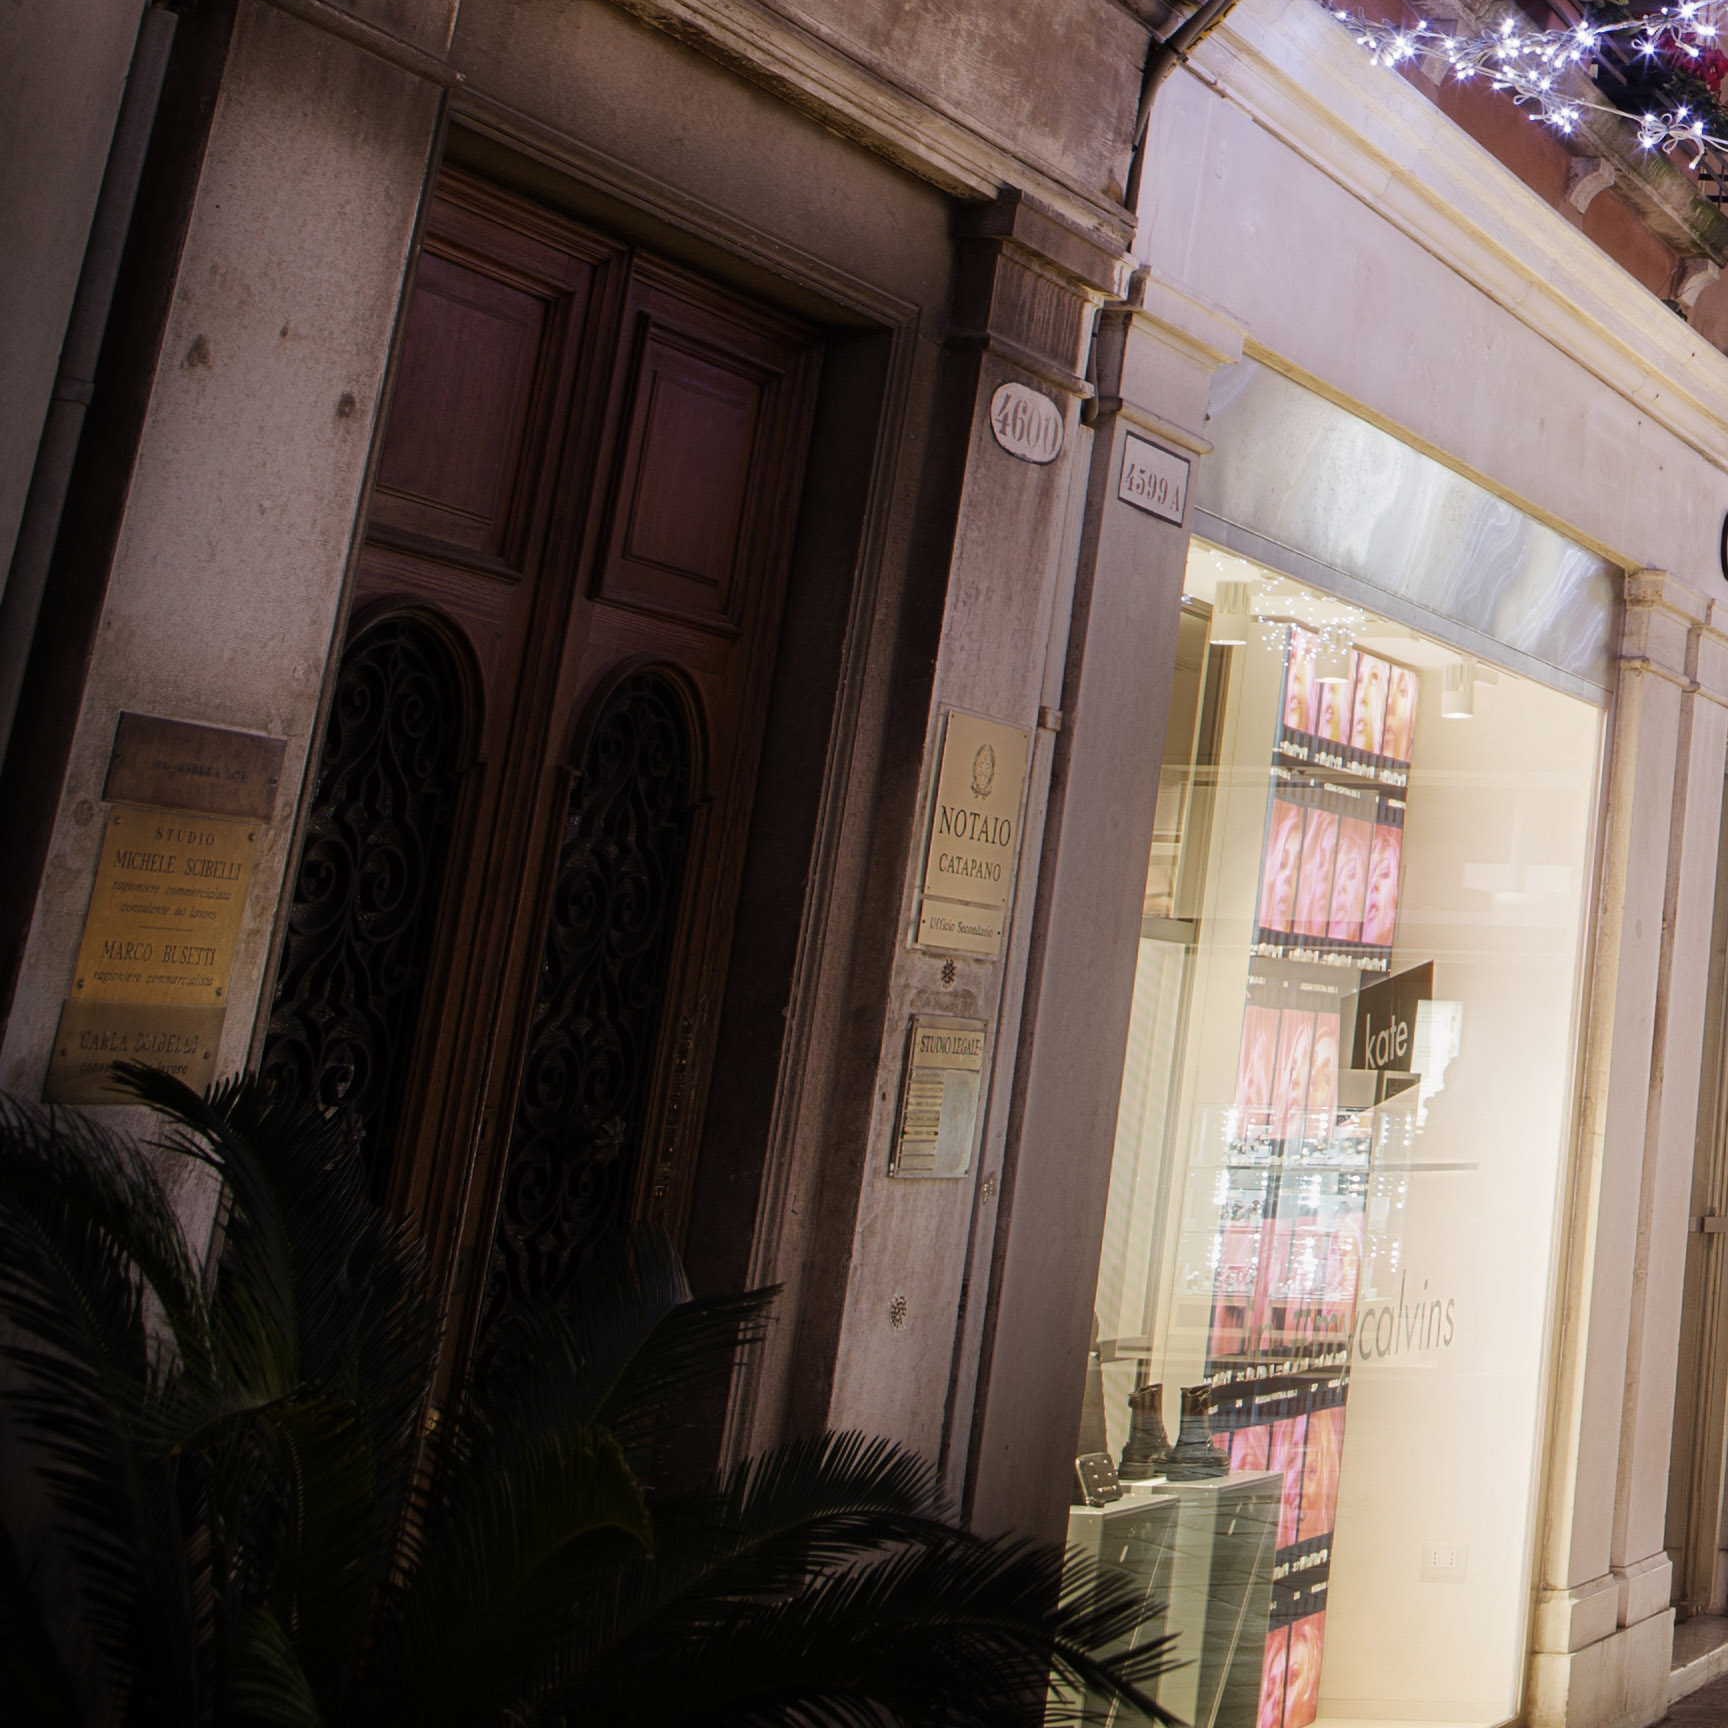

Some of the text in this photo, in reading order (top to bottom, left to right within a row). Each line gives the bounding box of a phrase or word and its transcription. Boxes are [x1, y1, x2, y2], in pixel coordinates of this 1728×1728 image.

[995, 393, 1059, 455] 4600
[1125, 463, 1182, 513] 4599 A
[154, 827, 216, 847] STUDIO
[938, 805, 1012, 848] NOTAIO
[112, 849, 243, 881] MICHELE SCIBELLI
[938, 853, 1002, 882] CATAPANO
[100, 939, 217, 967] MARCO BUSETTI
[80, 1031, 129, 1052] CARLA
[919, 1034, 981, 1056] STUDIO LEGALE
[1365, 1013, 1408, 1070] kate
